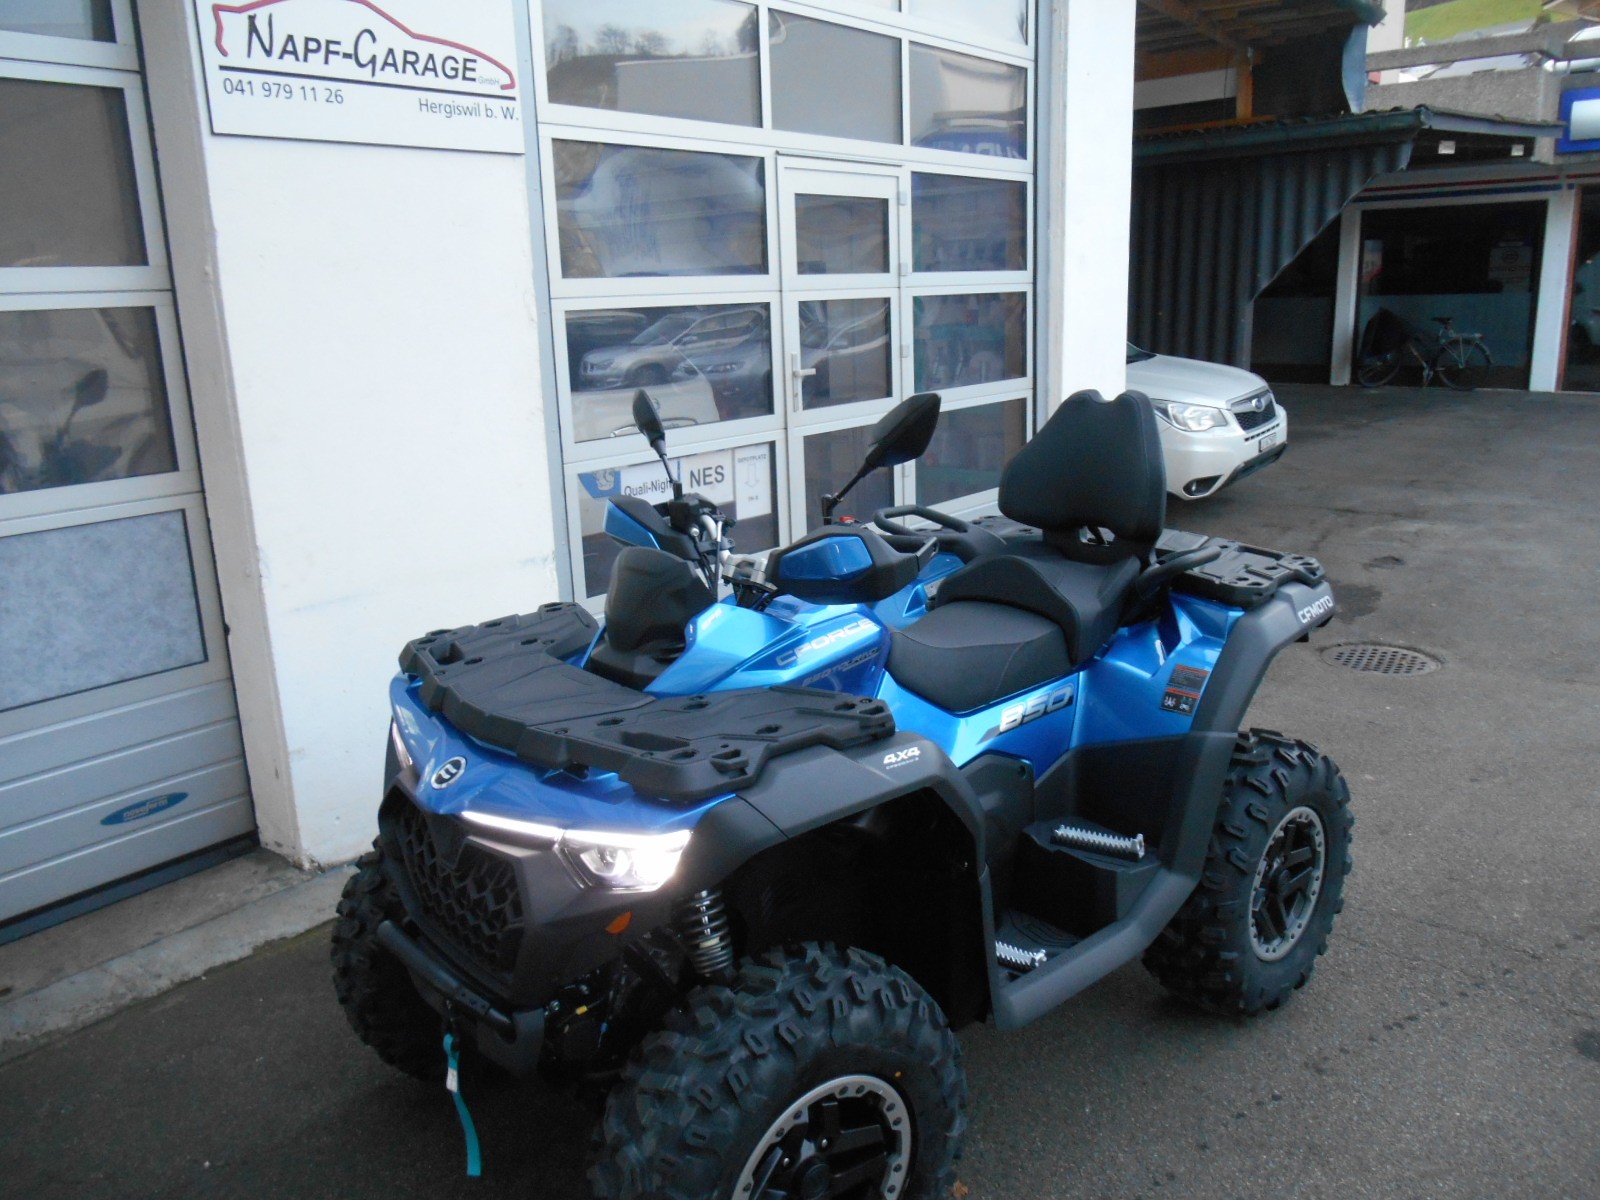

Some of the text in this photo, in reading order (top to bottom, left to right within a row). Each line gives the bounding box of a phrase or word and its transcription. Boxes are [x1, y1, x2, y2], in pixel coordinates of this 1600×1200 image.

[223, 78, 344, 104] 041 979 11 26
[478, 76, 500, 86] GmbH
[419, 98, 519, 120] Hergiswil b. W.
[624, 477, 672, 496] Quali-Nigh
[1297, 595, 1334, 624] CFMOTO
[776, 618, 874, 666] CFORCE
[1000, 683, 1074, 732] 850
